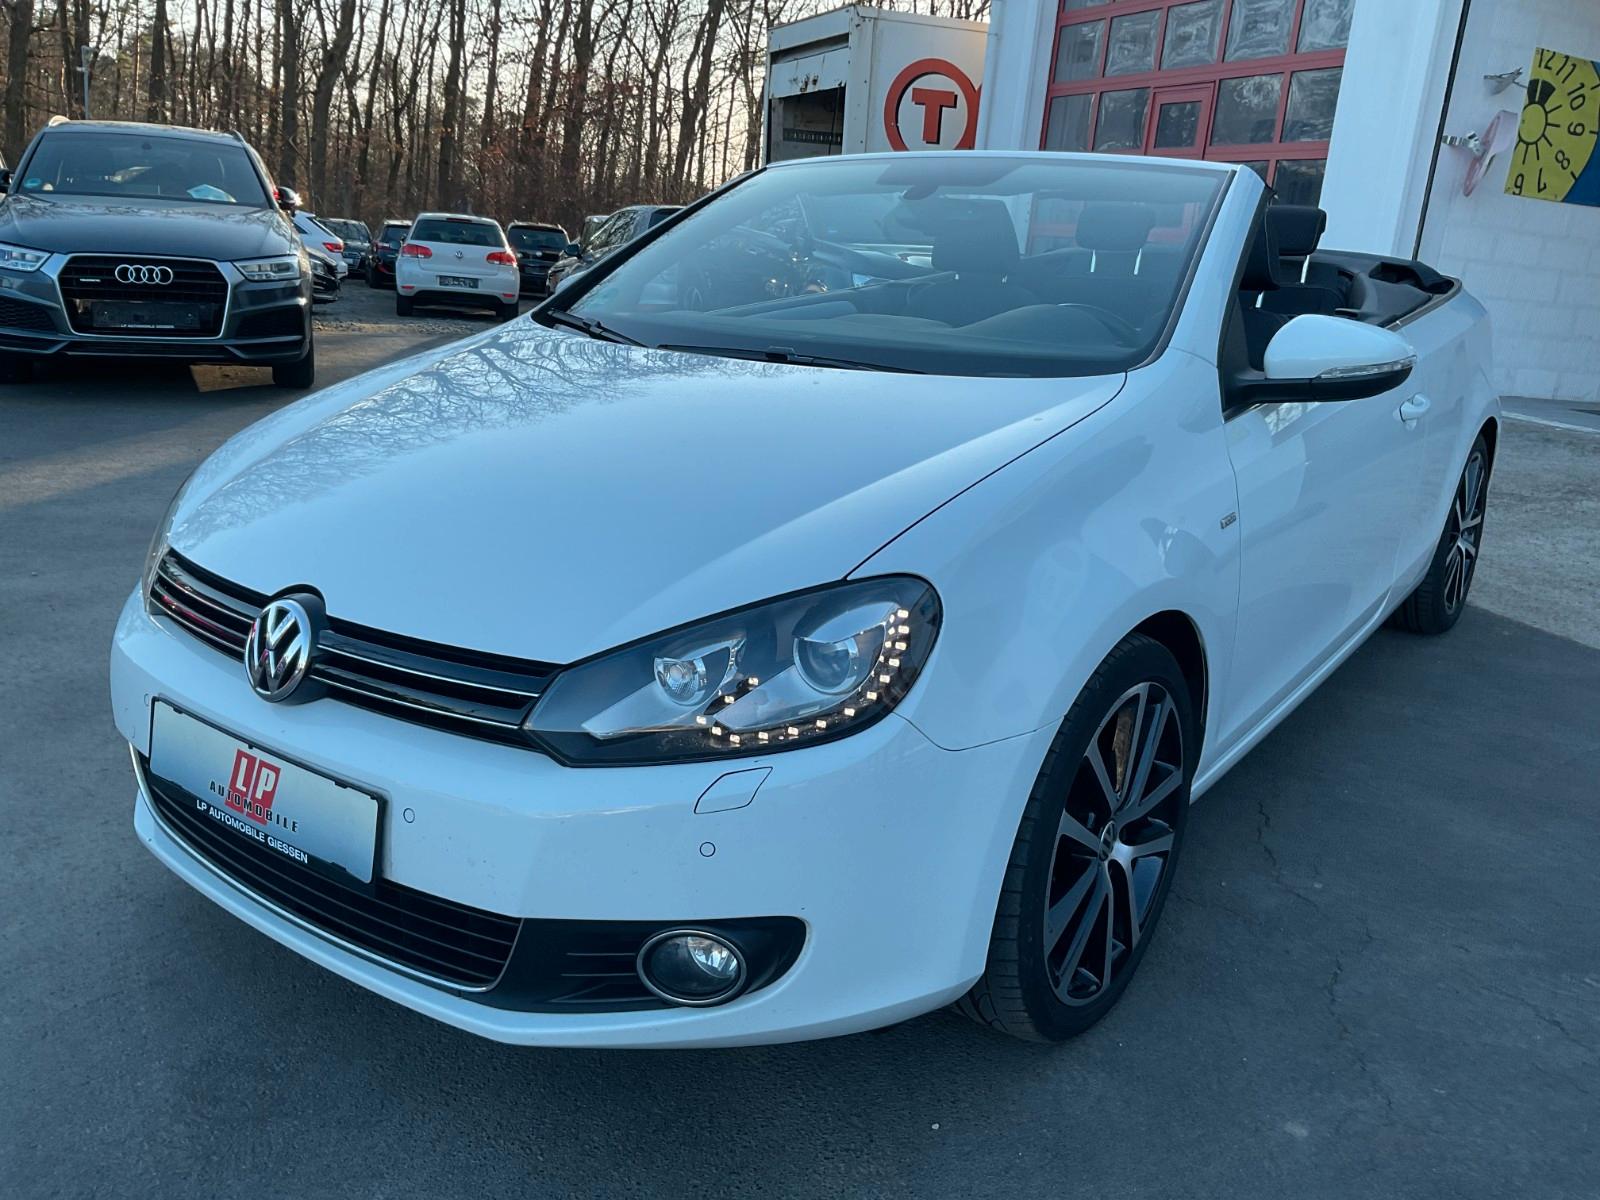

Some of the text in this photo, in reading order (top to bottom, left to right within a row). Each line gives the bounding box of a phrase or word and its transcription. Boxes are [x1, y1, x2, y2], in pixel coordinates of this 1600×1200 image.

[1538, 48, 1557, 70] 12
[1555, 55, 1577, 84] 11
[1567, 82, 1586, 111] 10
[911, 87, 958, 145] T
[1554, 149, 1571, 171] 8
[235, 757, 276, 800] LP
[209, 779, 300, 833] AUTOMOBILE
[196, 799, 308, 864] LP AUTOMOBILE GIESSEN
